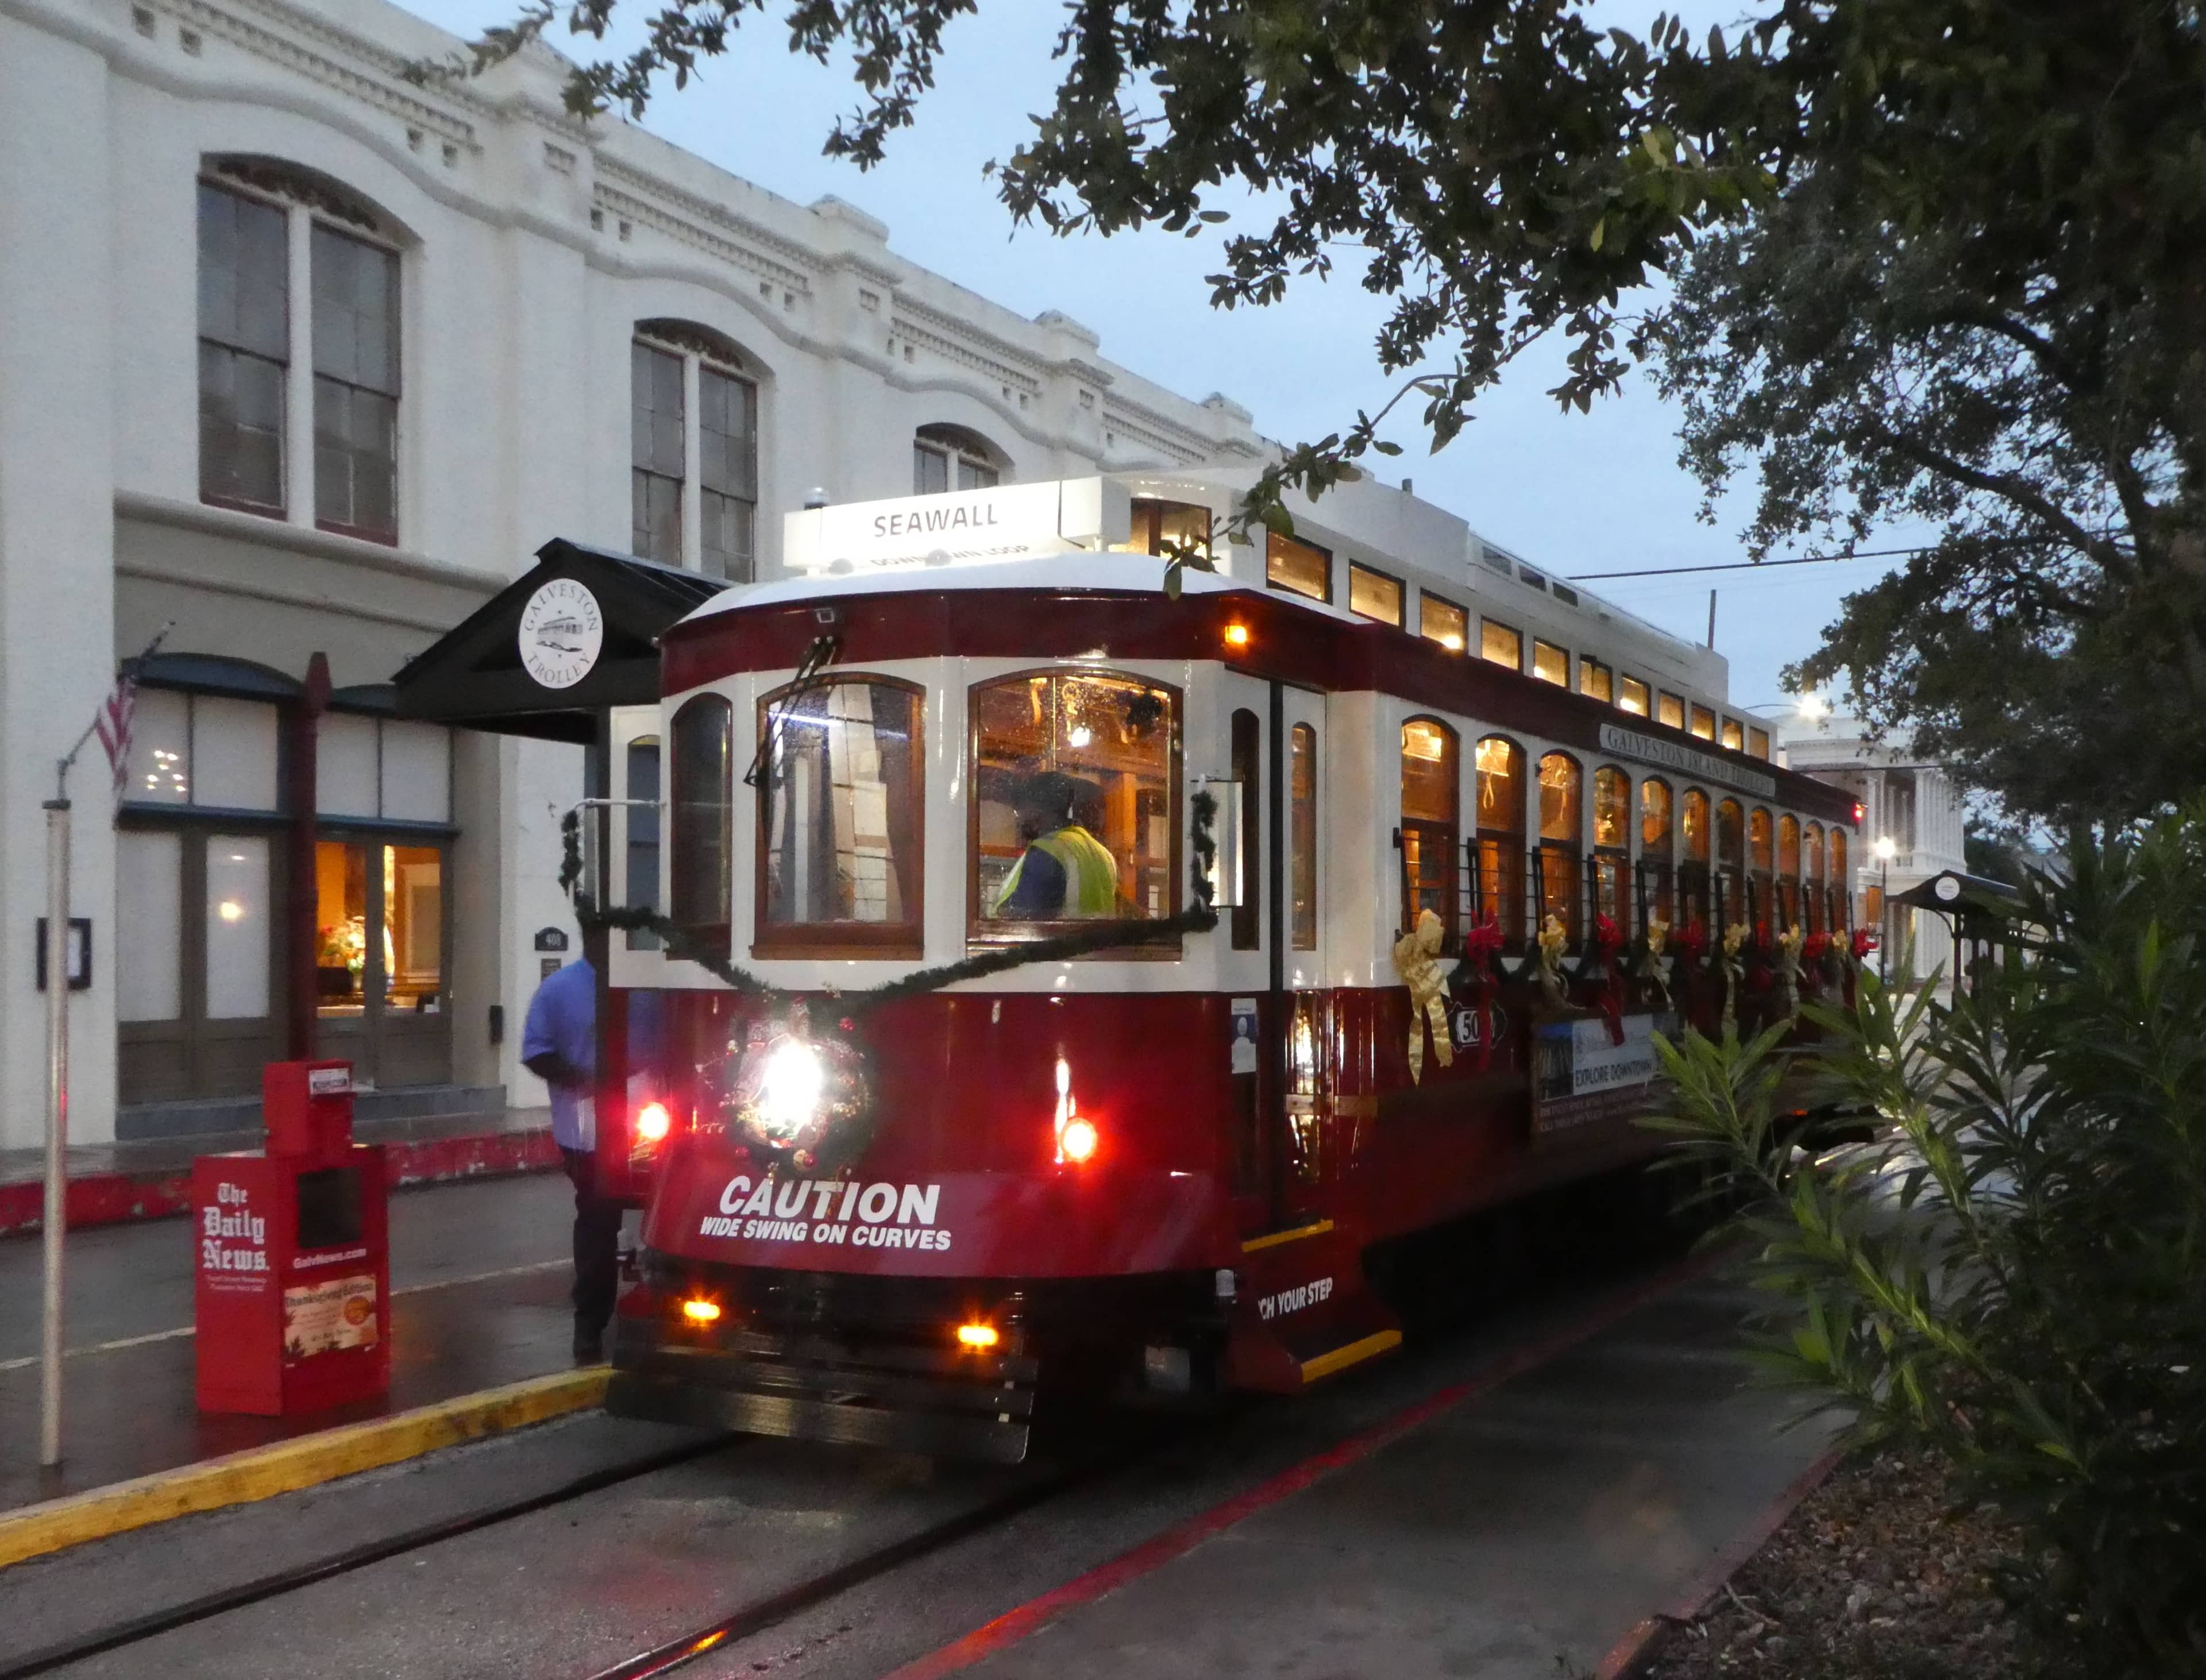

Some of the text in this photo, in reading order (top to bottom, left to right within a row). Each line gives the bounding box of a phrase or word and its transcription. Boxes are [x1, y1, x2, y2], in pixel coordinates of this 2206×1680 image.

[874, 504, 998, 537] SEAWALL
[524, 584, 597, 631] GALVESTON
[527, 652, 590, 683] TROLLEY
[1609, 728, 1683, 766] GALVESTON
[1688, 752, 1727, 779] ISLAND
[1575, 1064, 1609, 1087] EXPLORE
[218, 1182, 248, 1207] The
[719, 1175, 941, 1225] CAUTION
[203, 1207, 265, 1245] Daily
[700, 1216, 952, 1251] WIDE SWING ON CURVES
[1277, 1286, 1306, 1315] YOUR
[1308, 1277, 1333, 1305] STEP
